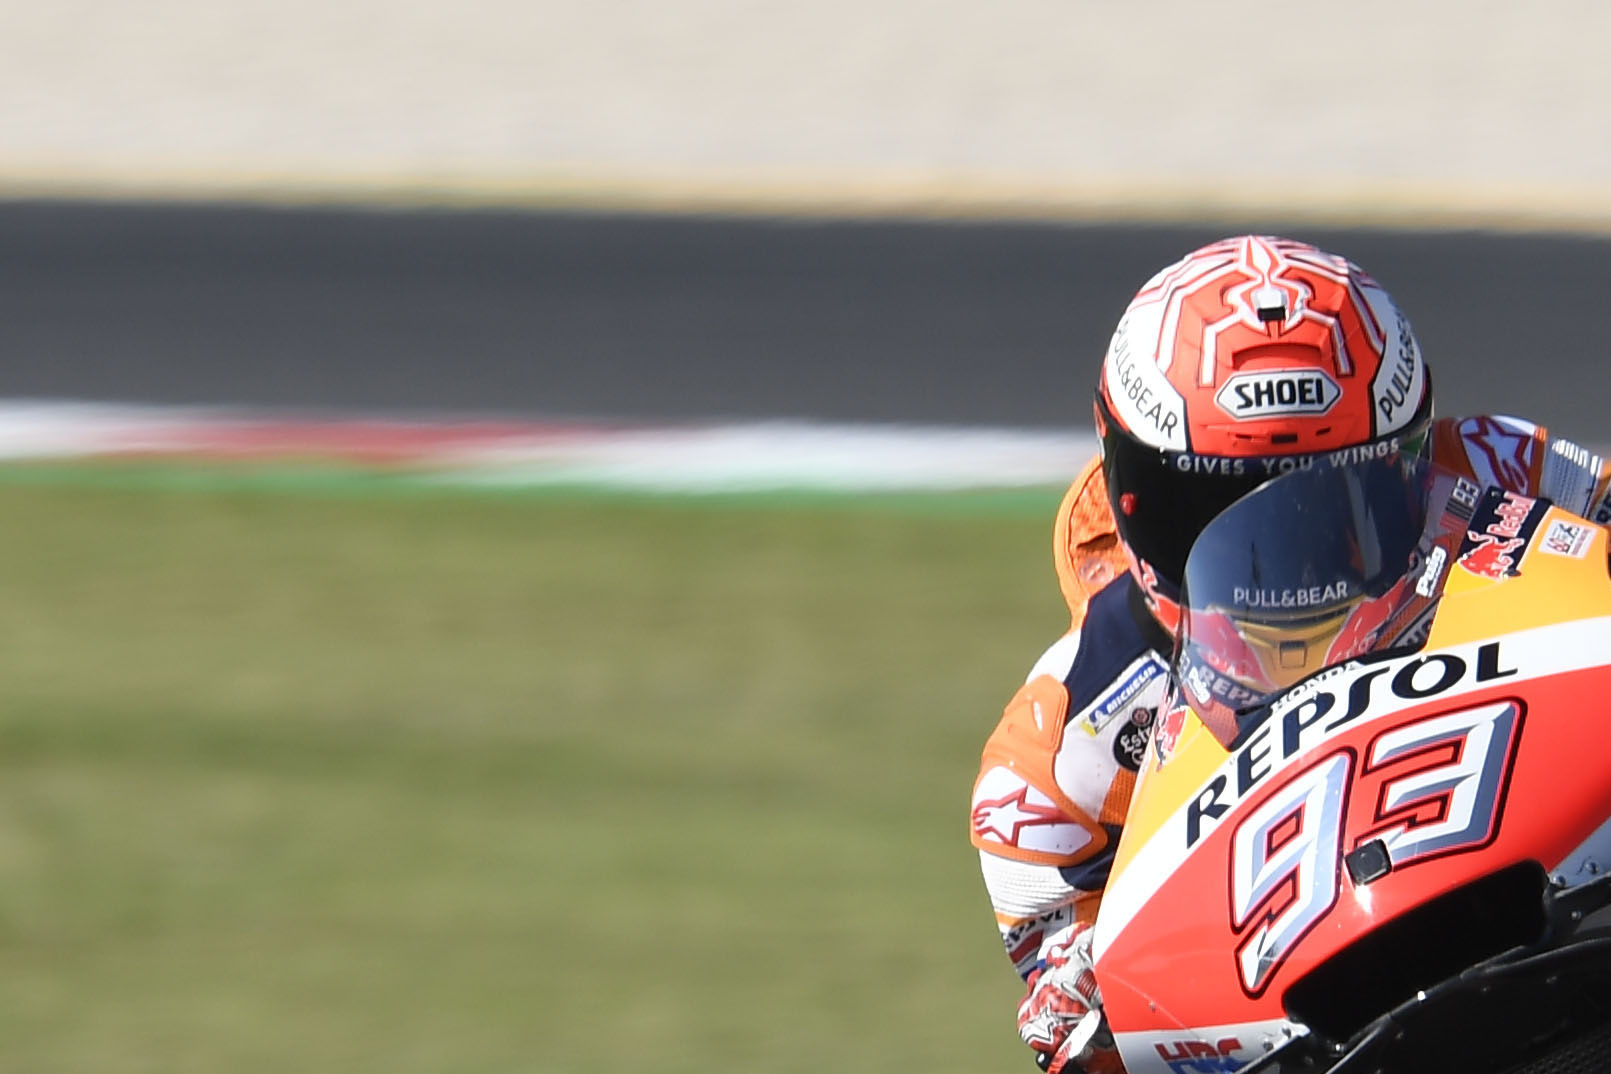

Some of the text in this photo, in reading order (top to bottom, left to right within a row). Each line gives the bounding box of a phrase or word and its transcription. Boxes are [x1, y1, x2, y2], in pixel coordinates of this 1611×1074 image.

[1234, 378, 1325, 409] SHOEI
[1176, 453, 1245, 476] GIVES
[1261, 455, 1314, 475] YOU
[1328, 439, 1400, 469] WINGS
[1233, 581, 1349, 608] PULL&BEAR
[1106, 663, 1157, 714] MICHELIN
[1270, 661, 1365, 712] HONDA
[1186, 643, 1519, 849] REPSOL
[1229, 695, 1527, 999] 93
